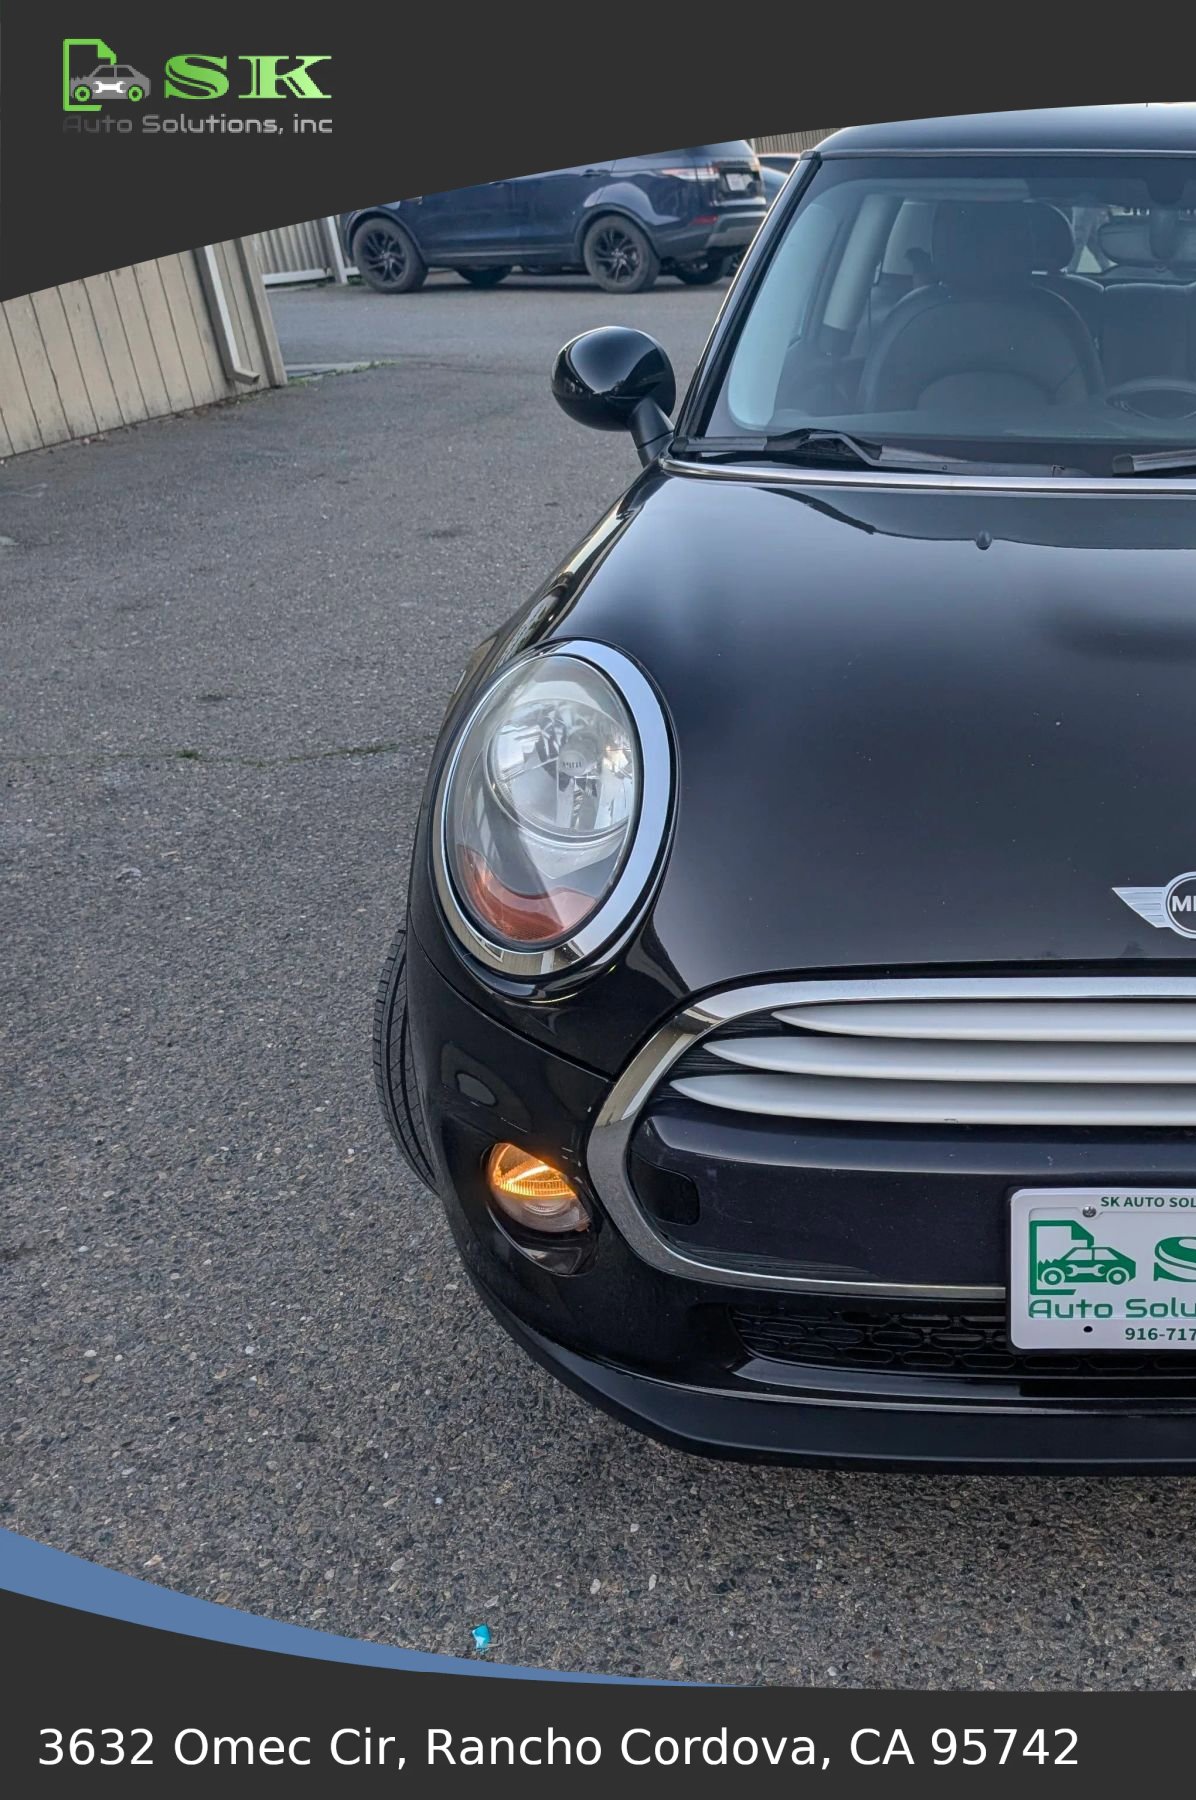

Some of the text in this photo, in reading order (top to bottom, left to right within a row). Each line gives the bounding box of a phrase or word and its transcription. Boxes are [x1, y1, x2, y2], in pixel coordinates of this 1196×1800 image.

[1100, 1196, 1121, 1208] SK
[1123, 1196, 1165, 1209] AUTO
[1028, 1297, 1114, 1319] Auto
